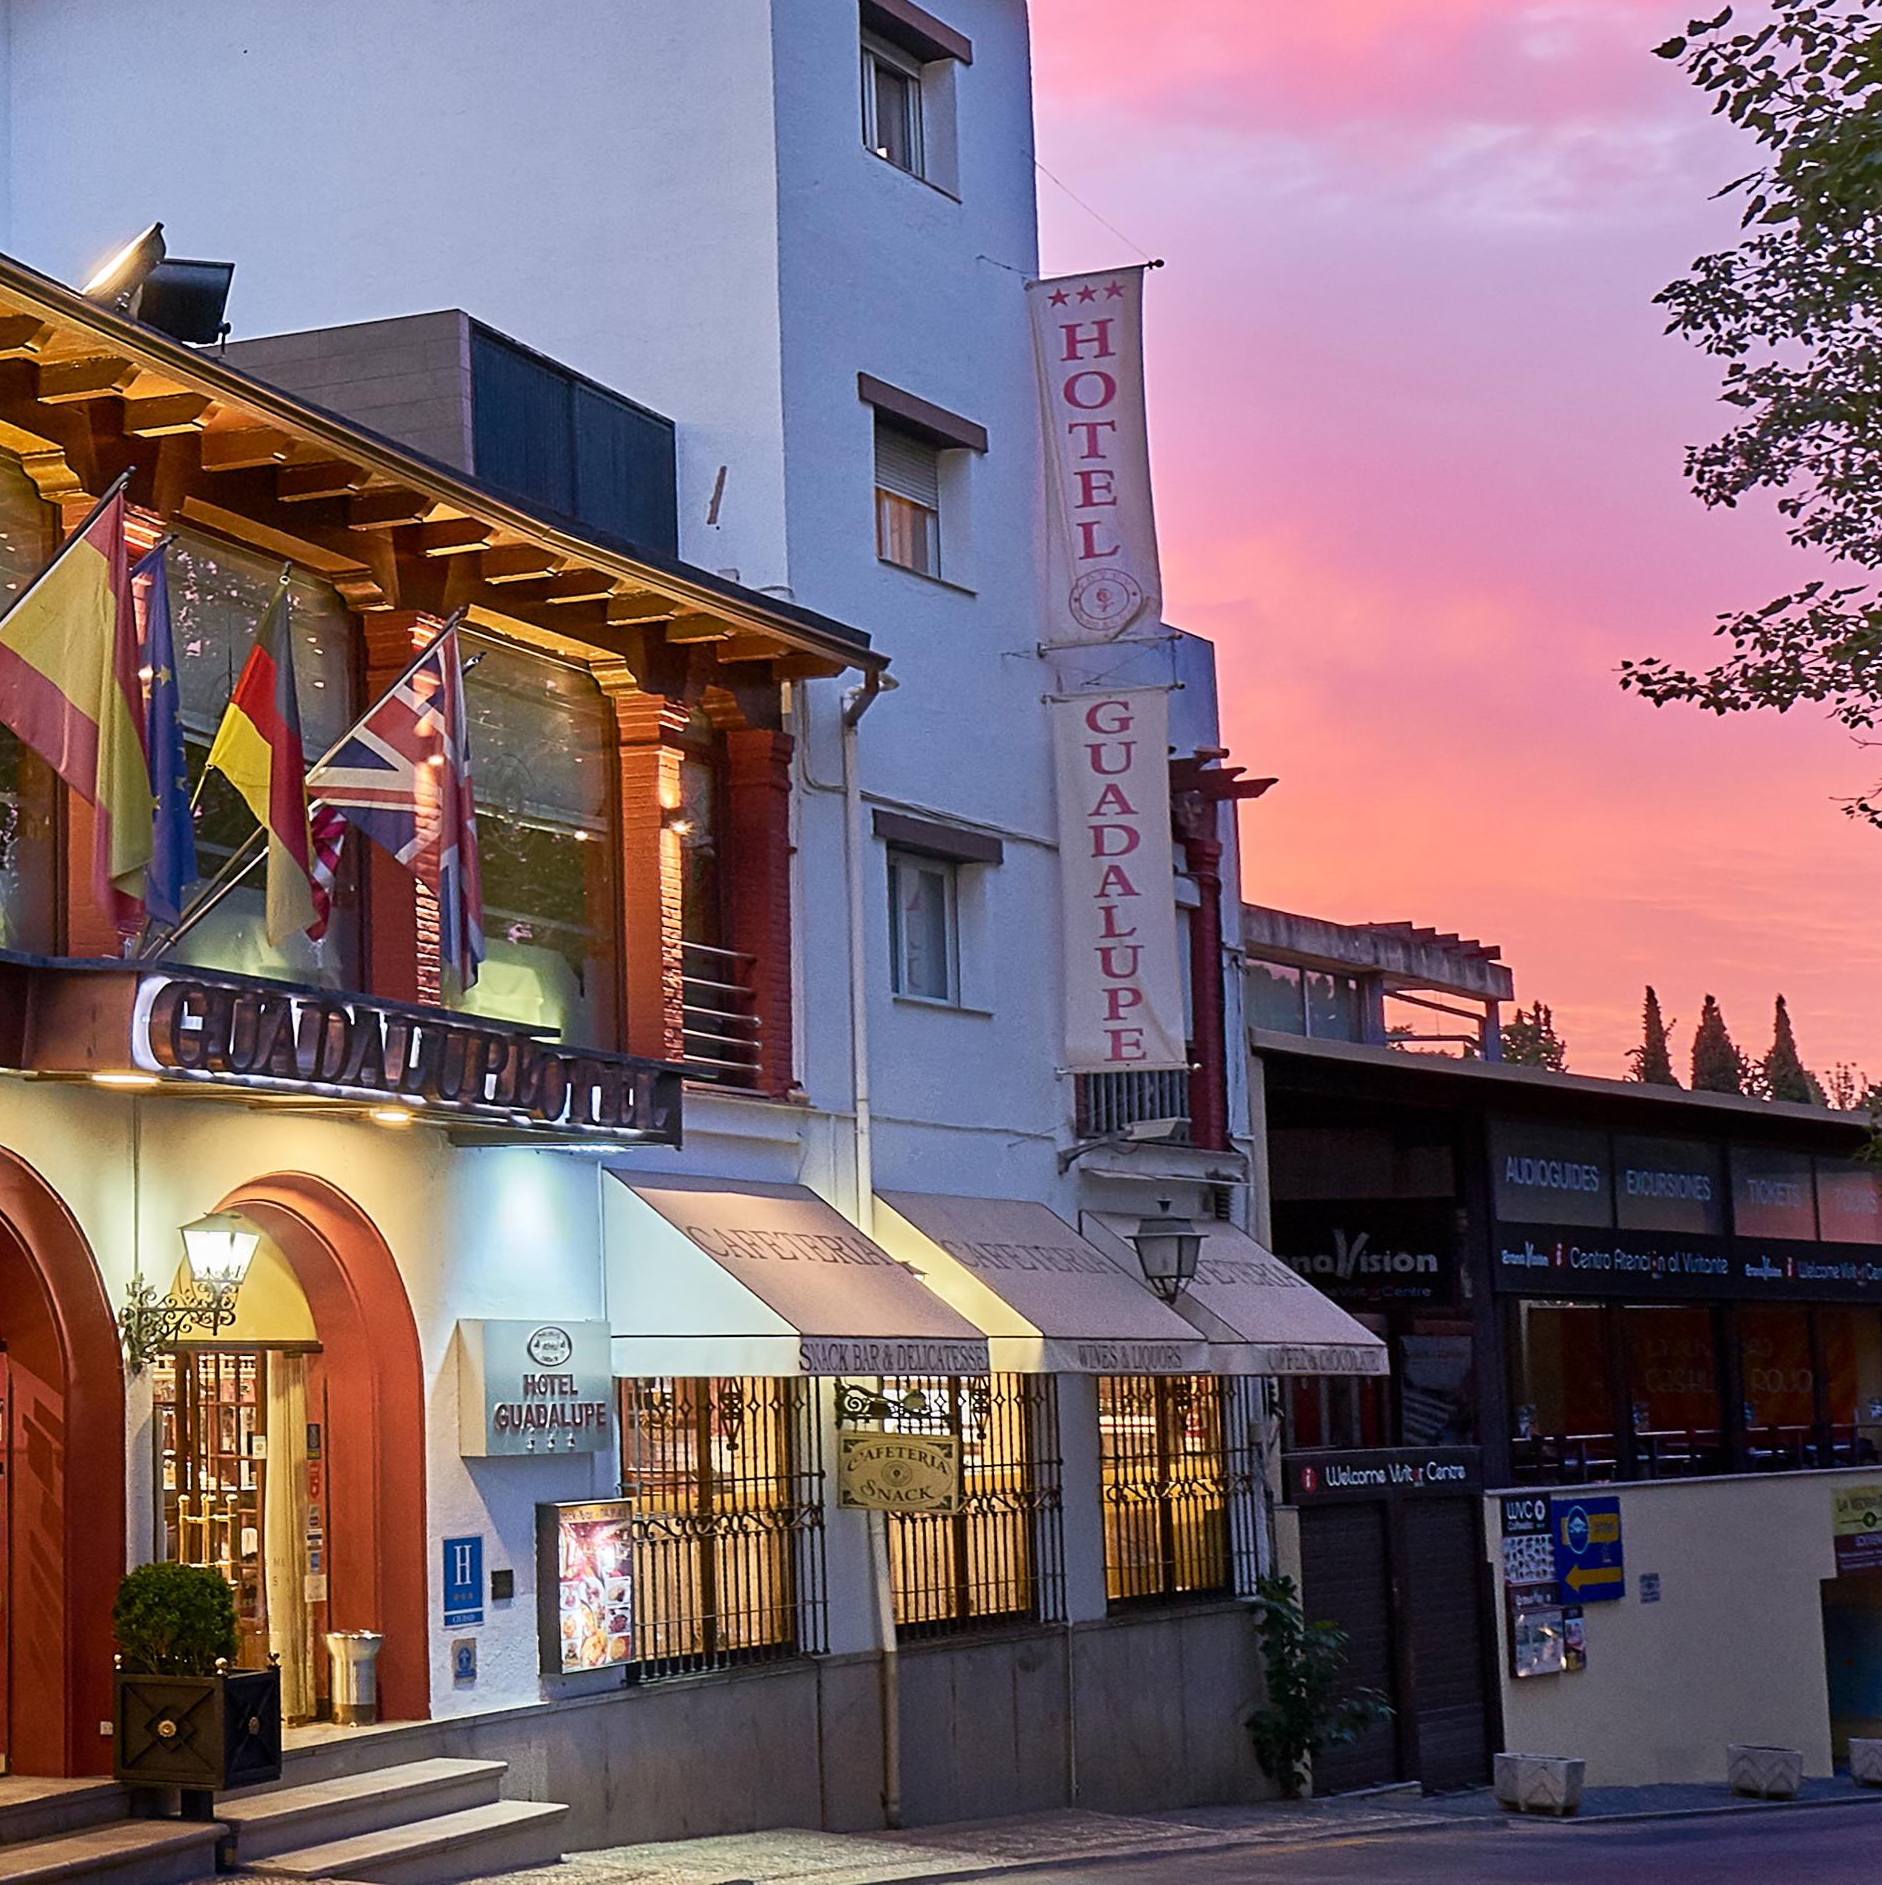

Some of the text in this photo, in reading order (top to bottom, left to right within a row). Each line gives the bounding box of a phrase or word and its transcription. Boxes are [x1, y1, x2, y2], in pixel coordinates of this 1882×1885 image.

[1060, 316, 1121, 560] HOTEL
[1086, 700, 1148, 1063] GUADALUPE
[150, 981, 539, 1106] GUADALUPE
[542, 1053, 668, 1131] OTEL
[1505, 1156, 1600, 1193] AUDIOGUIDES
[1625, 1169, 1712, 1201] EXCURSIONES
[1747, 1179, 1801, 1208] TICKETS
[686, 1226, 895, 1267] CAFETERIA
[941, 1239, 1120, 1275] CAFETERIA
[1570, 1247, 1611, 1271] Centro
[1190, 1259, 1310, 1288] FETERIA
[799, 1342, 847, 1373] SNACK
[853, 1345, 879, 1371] BAR
[882, 1345, 895, 1371] &
[1078, 1344, 1117, 1369] WINES
[1132, 1345, 1182, 1372] LIQUORS
[523, 1373, 579, 1396] HOTEL
[494, 1403, 607, 1430] GUADALUPE
[847, 1446, 948, 1475] CAFETERIA
[1325, 1466, 1386, 1487] Welcome
[1426, 1461, 1466, 1481] Centre
[860, 1479, 933, 1502] SNACK
[454, 1545, 472, 1586] H
